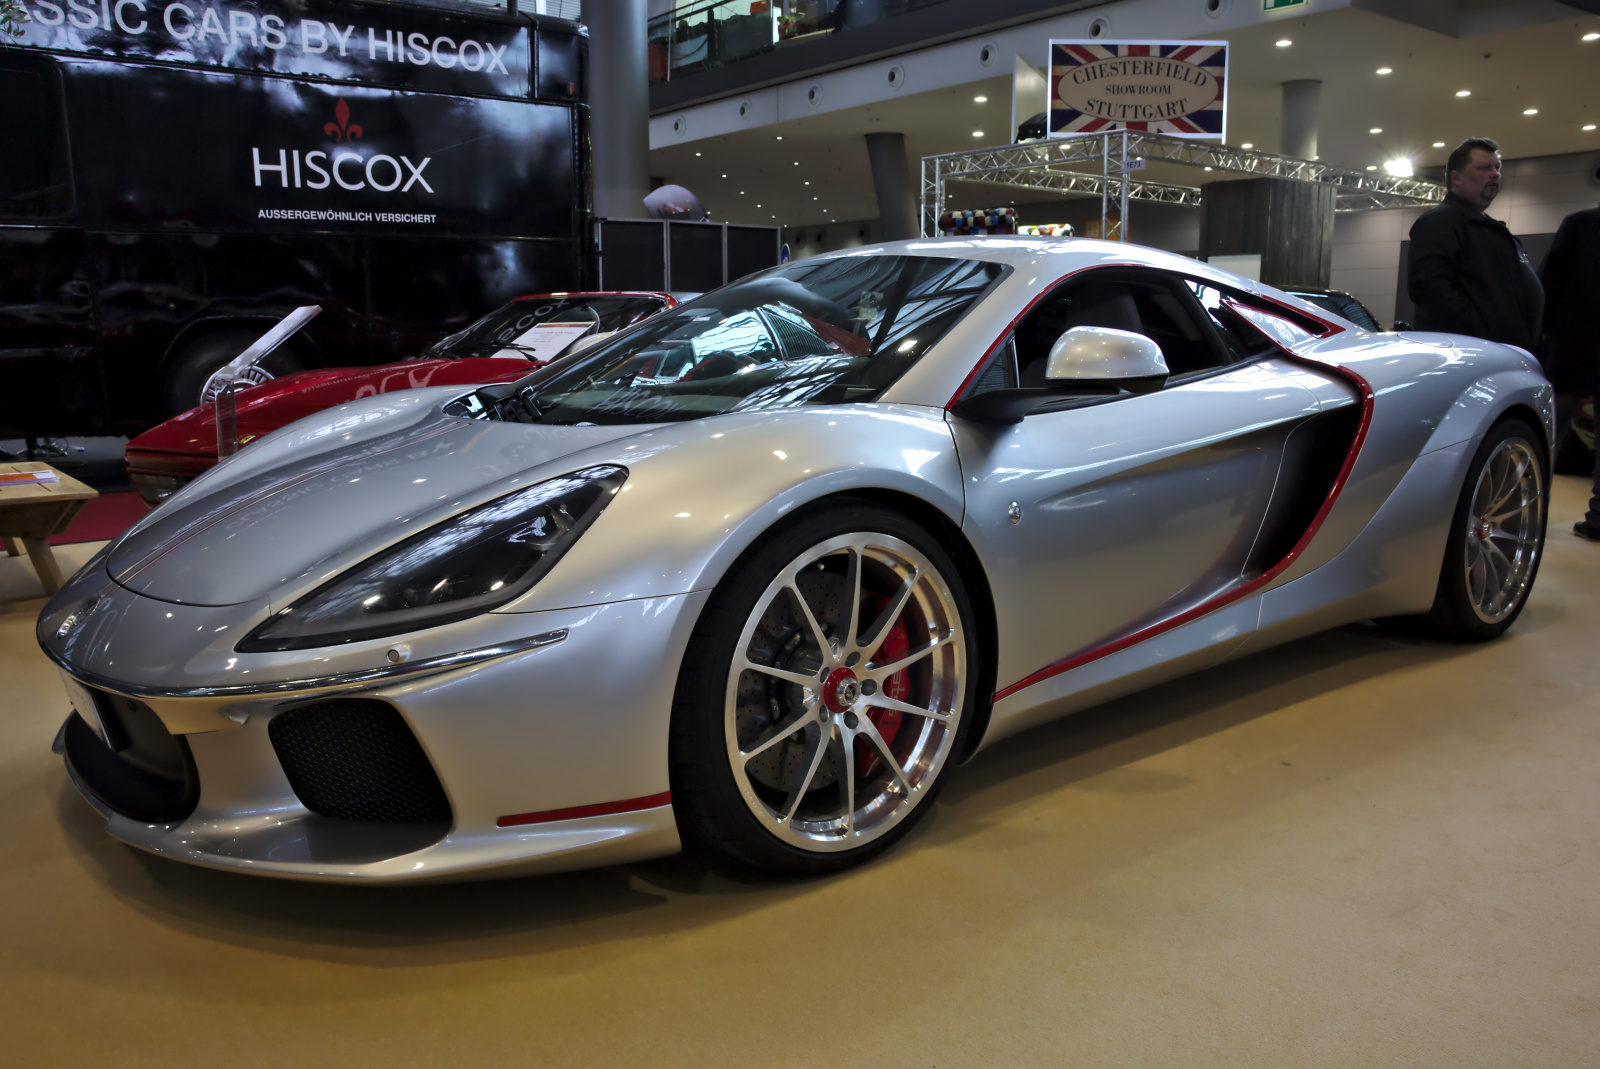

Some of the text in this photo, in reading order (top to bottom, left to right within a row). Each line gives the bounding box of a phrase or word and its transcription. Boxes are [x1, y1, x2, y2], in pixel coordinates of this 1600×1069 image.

[6, 0, 509, 76] SSIC CARS BY HISCOX
[1073, 60, 1207, 87] CHESTERFIELD
[1105, 84, 1172, 95] SHOWROOM
[1085, 98, 1187, 119] STUTTGART
[252, 146, 434, 193] HISCOX
[257, 208, 437, 224] AUSSERGEWÖHNLICH VERSICHERT
